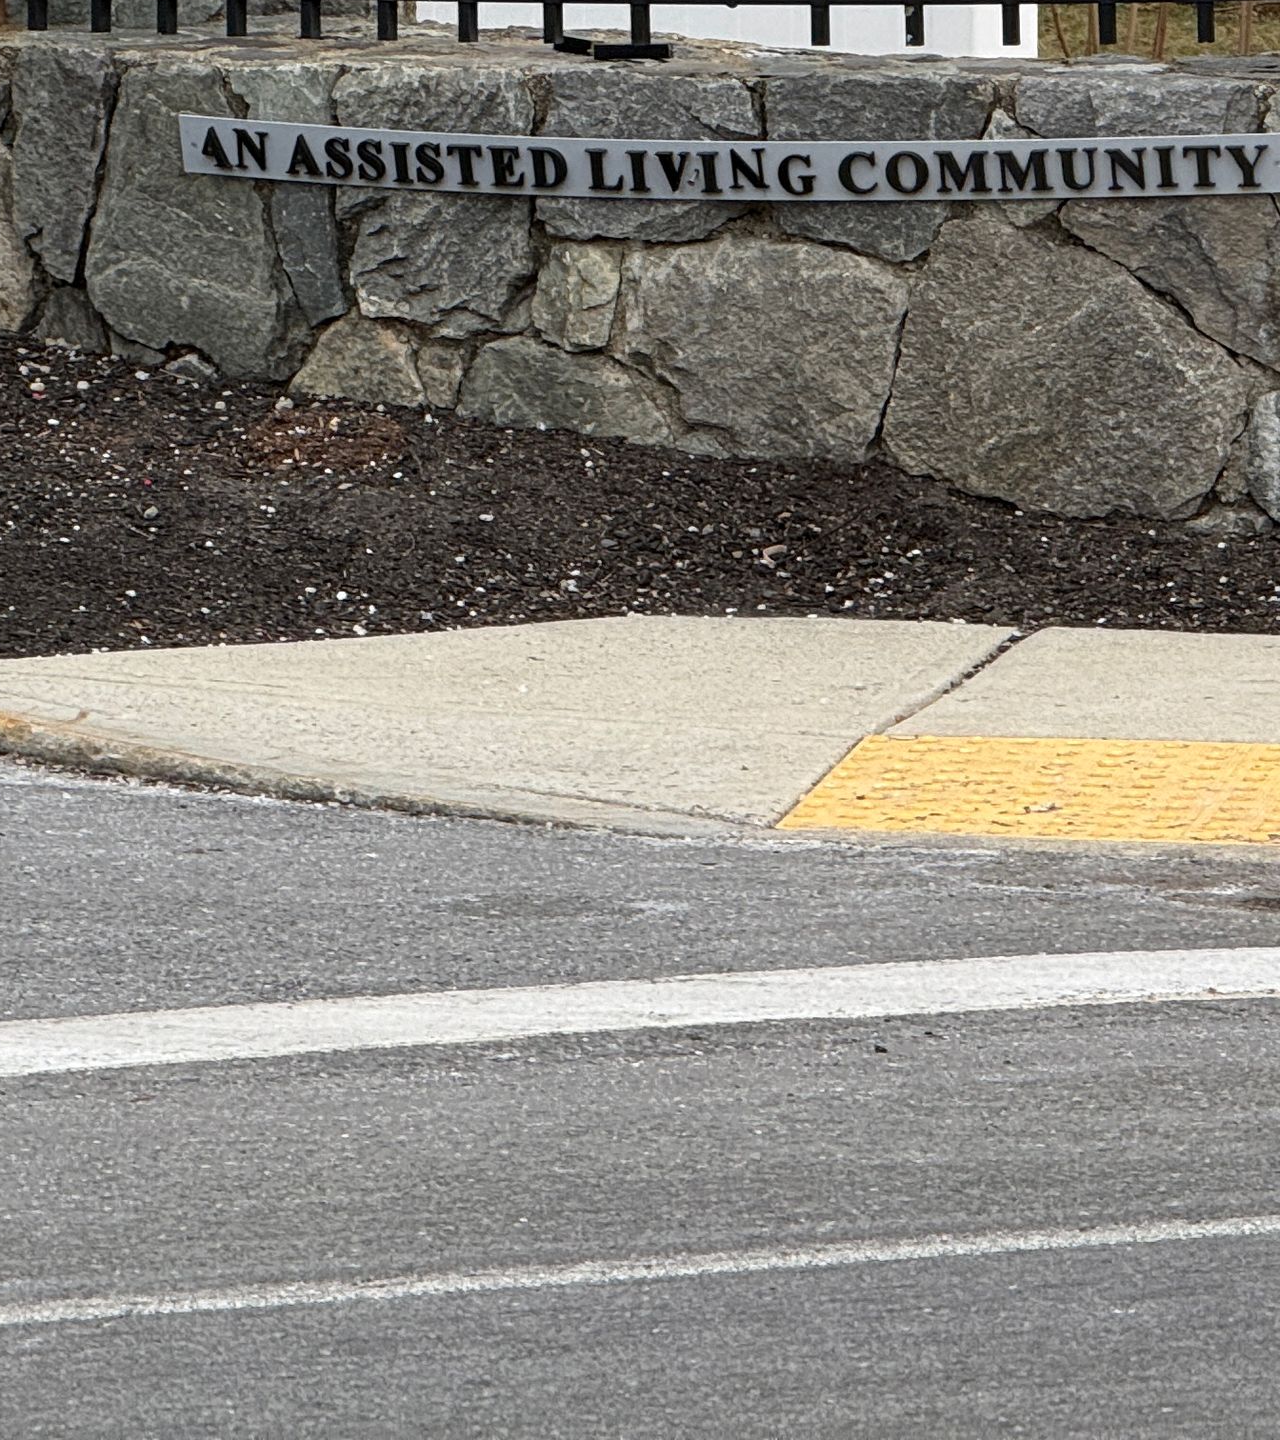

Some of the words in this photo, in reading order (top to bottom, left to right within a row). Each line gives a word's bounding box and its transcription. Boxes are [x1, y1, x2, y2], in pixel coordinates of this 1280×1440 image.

[201, 126, 268, 171] AN
[286, 133, 568, 190] ASSISTED
[584, 147, 816, 195] LIVING
[838, 144, 1269, 194] COMMUNITY
